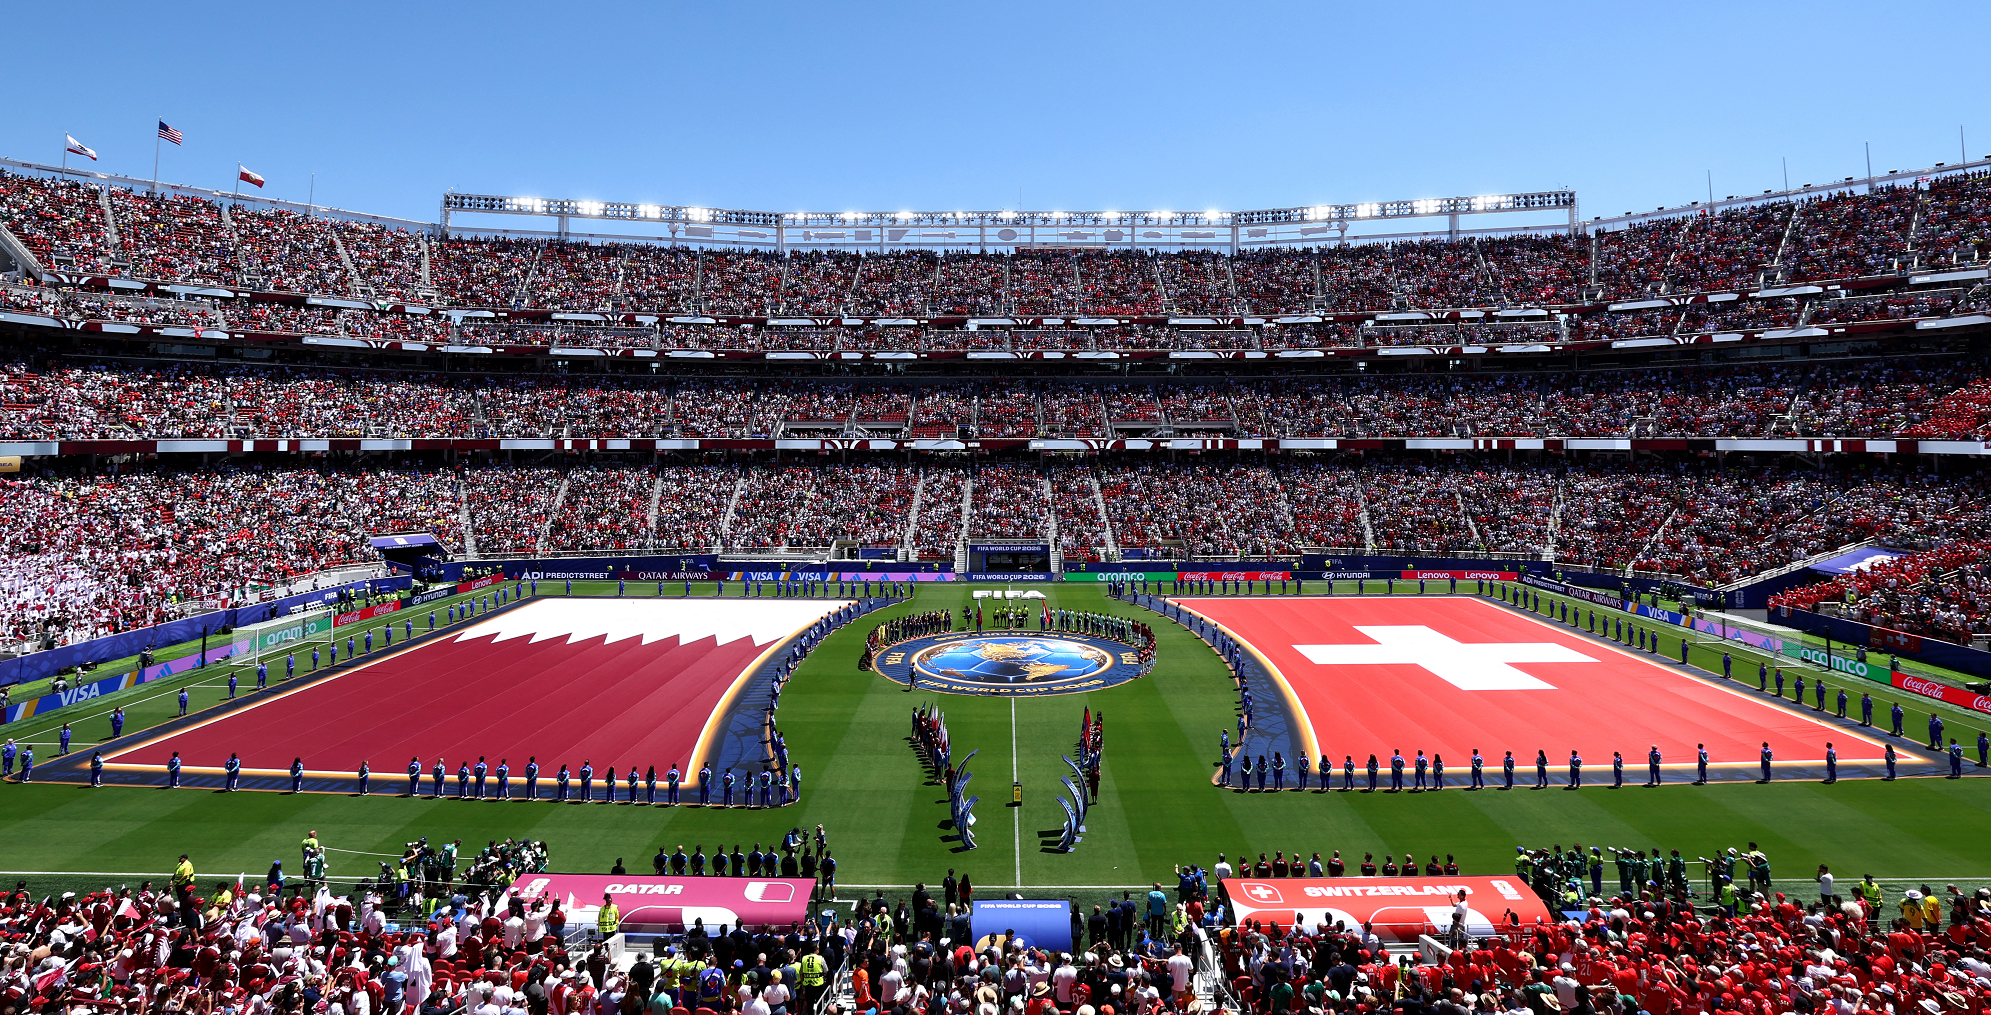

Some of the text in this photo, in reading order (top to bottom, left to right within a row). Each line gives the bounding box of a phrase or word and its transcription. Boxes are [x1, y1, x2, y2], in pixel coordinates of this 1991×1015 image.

[521, 572, 544, 580] ADI
[638, 571, 709, 580] QATAR AIRWAYS
[749, 572, 774, 580] VISA
[798, 572, 821, 581] VISA
[1097, 572, 1145, 581] aramco
[1417, 571, 1450, 579] Lenovo
[1465, 571, 1499, 580] Lenovo
[471, 578, 492, 590] Lenovo
[1533, 579, 1565, 592] PREDICTSTREET
[324, 592, 337, 600] FIFA
[423, 589, 448, 602] HYUNDAI
[972, 590, 1047, 600] FIFA
[1568, 587, 1622, 609] QATAR AIRWAYS
[1647, 606, 1670, 622] VISA
[1800, 648, 1868, 676] aramco
[917, 679, 949, 689] FIFA
[951, 685, 1012, 693] WORLD
[57, 682, 100, 707] VISA
[604, 883, 684, 895] QATAR
[1303, 885, 1474, 897] SWITZERLAND
[1909, 907, 1916, 917] 9
[1512, 934, 1521, 944] 11
